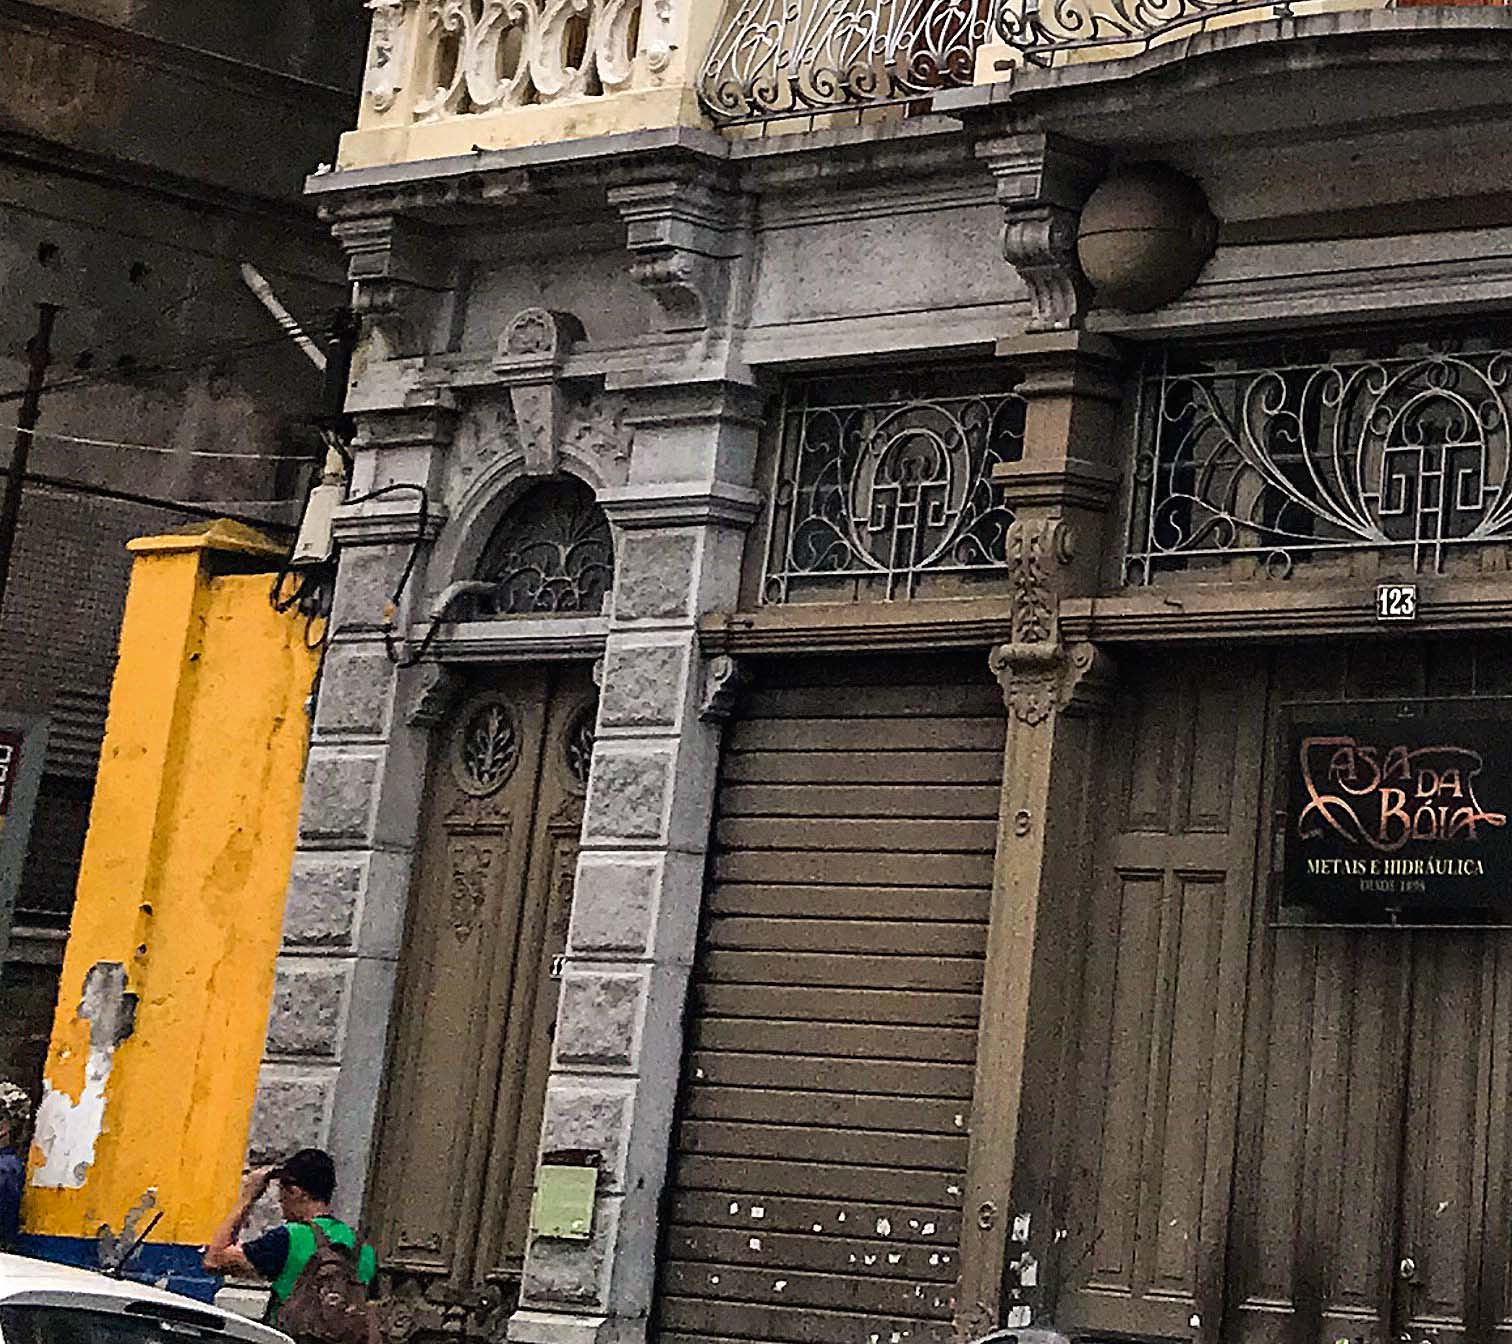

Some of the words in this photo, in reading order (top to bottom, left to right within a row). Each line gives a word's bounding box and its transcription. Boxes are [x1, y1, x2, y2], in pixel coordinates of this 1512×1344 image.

[1380, 588, 1414, 615] 123
[1415, 769, 1464, 798] DA
[1307, 859, 1367, 875] METAIS
[1370, 859, 1381, 875] E
[1384, 855, 1484, 876] HIDRÁULICA
